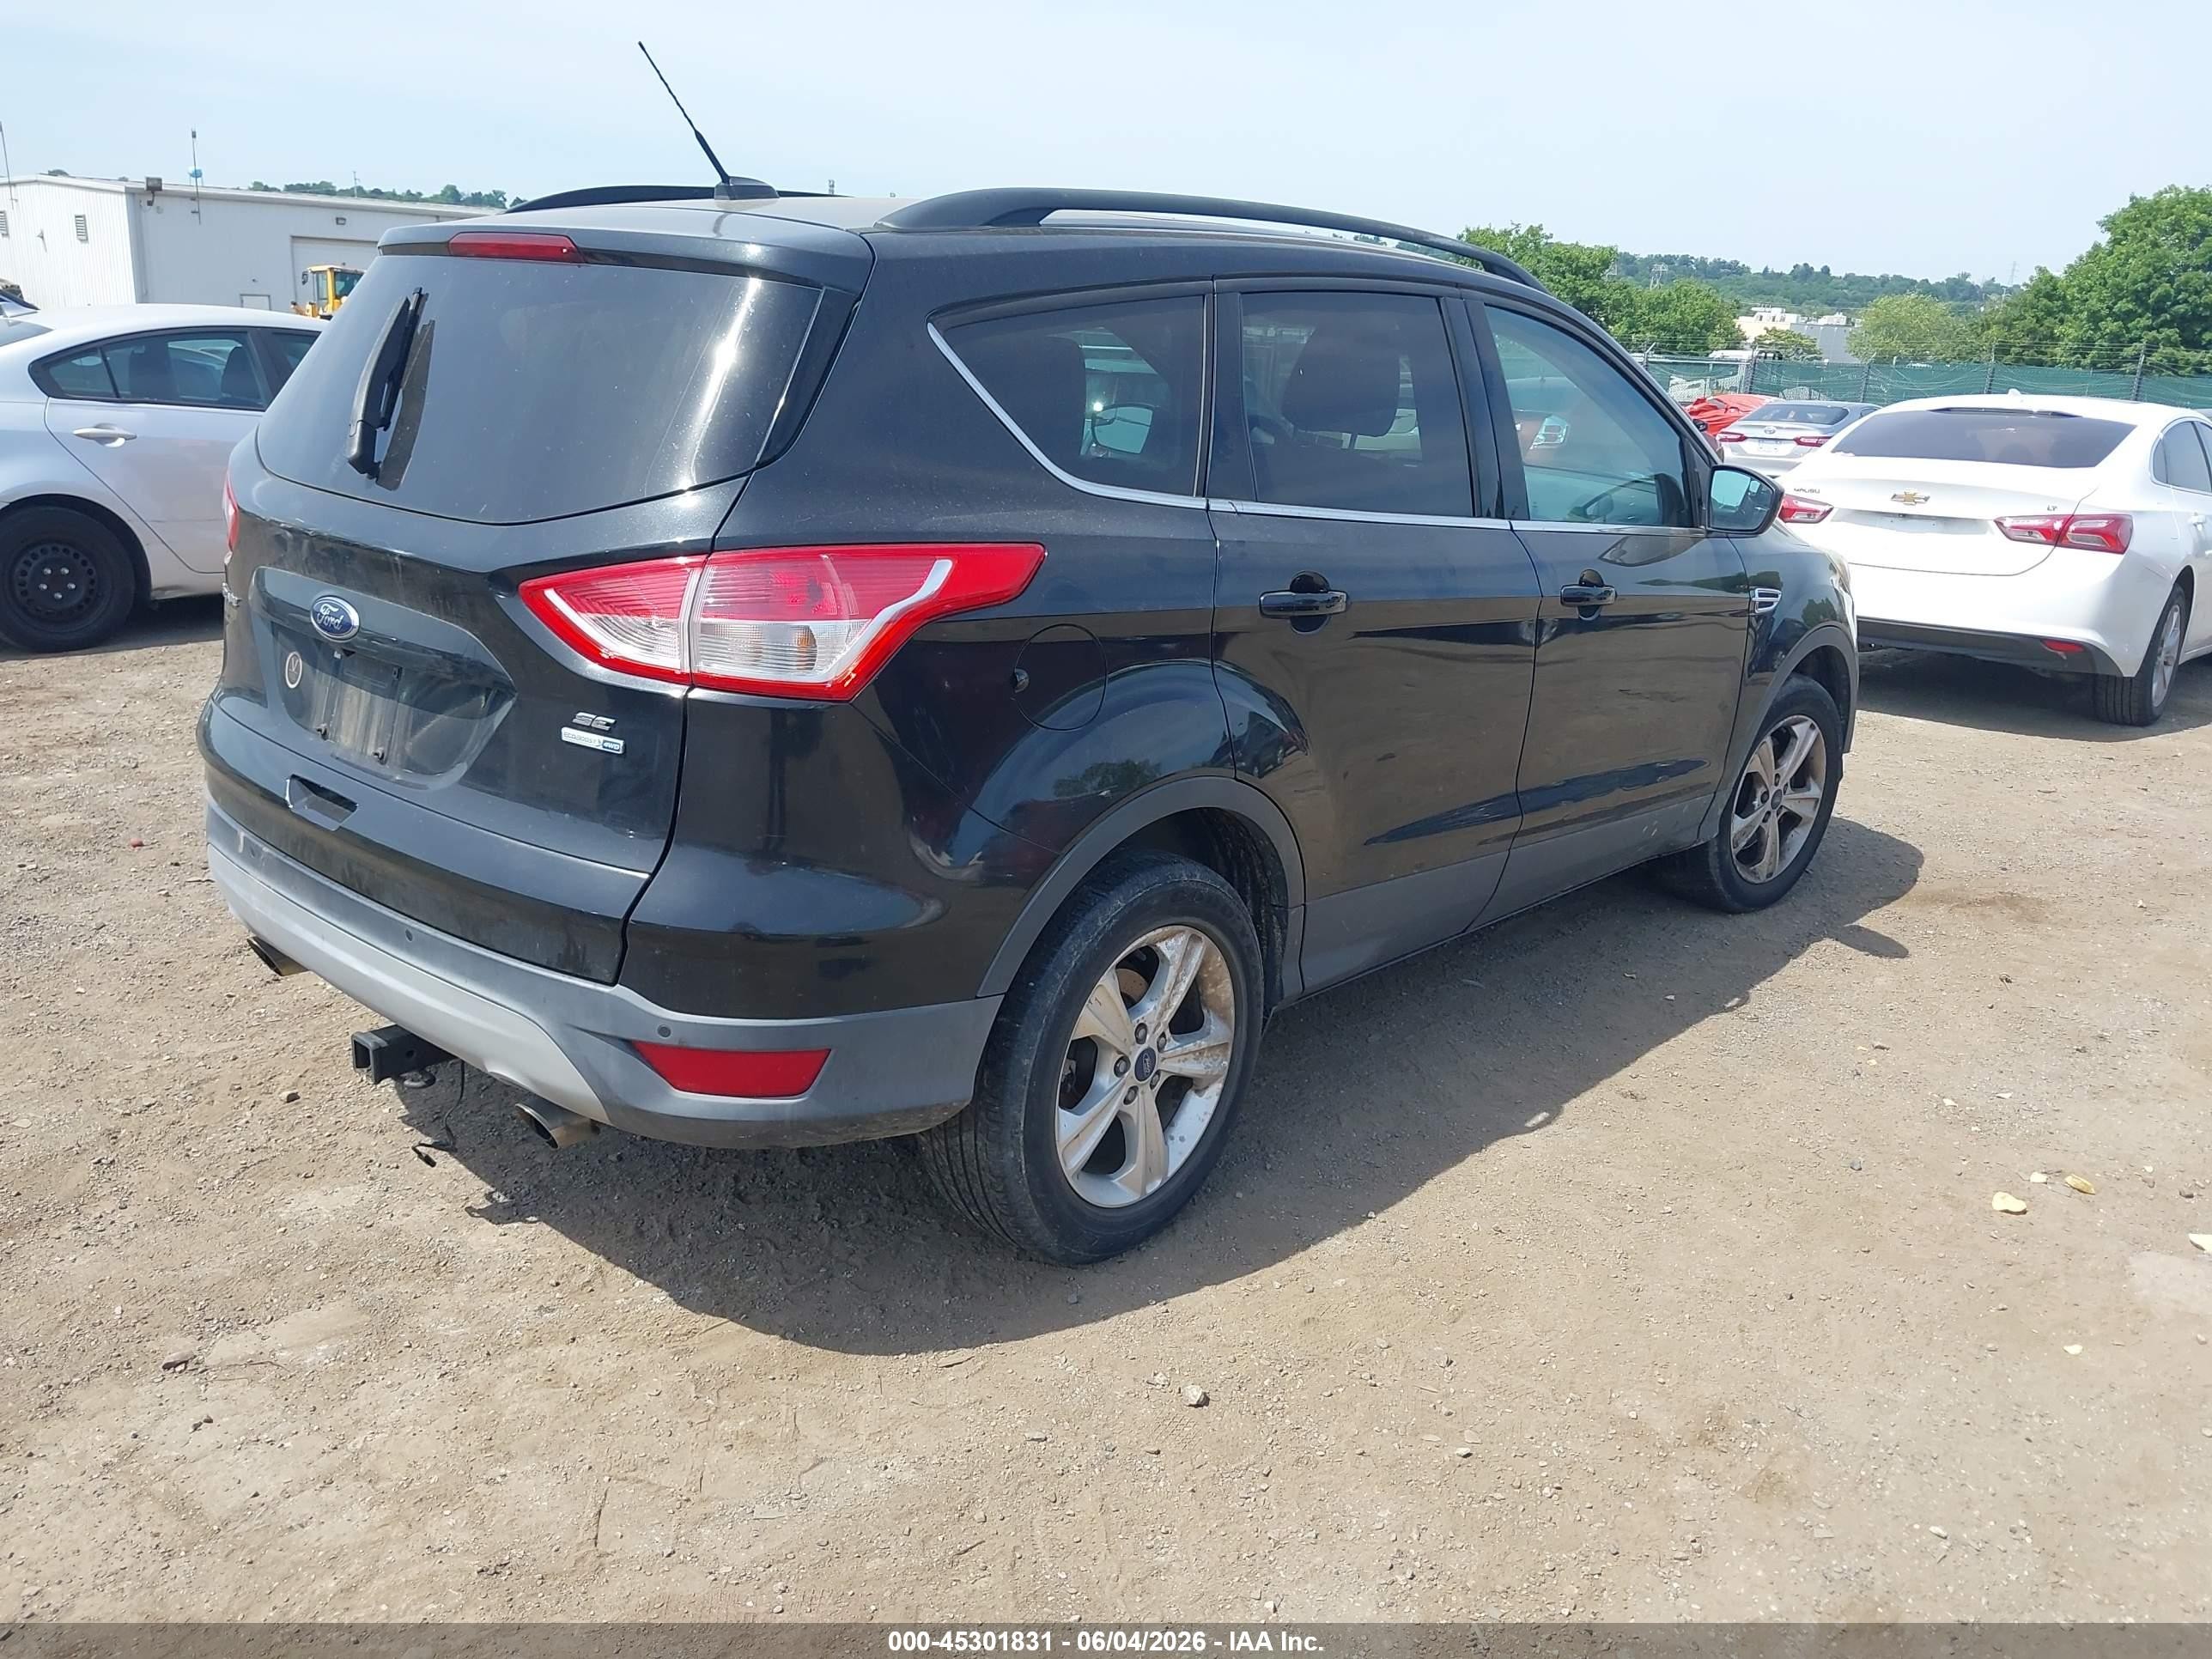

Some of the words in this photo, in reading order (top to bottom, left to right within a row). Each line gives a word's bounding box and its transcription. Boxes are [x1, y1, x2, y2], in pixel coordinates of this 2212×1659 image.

[316, 603, 345, 630] Ford
[572, 712, 617, 731] SE
[603, 741, 620, 750] 4WD
